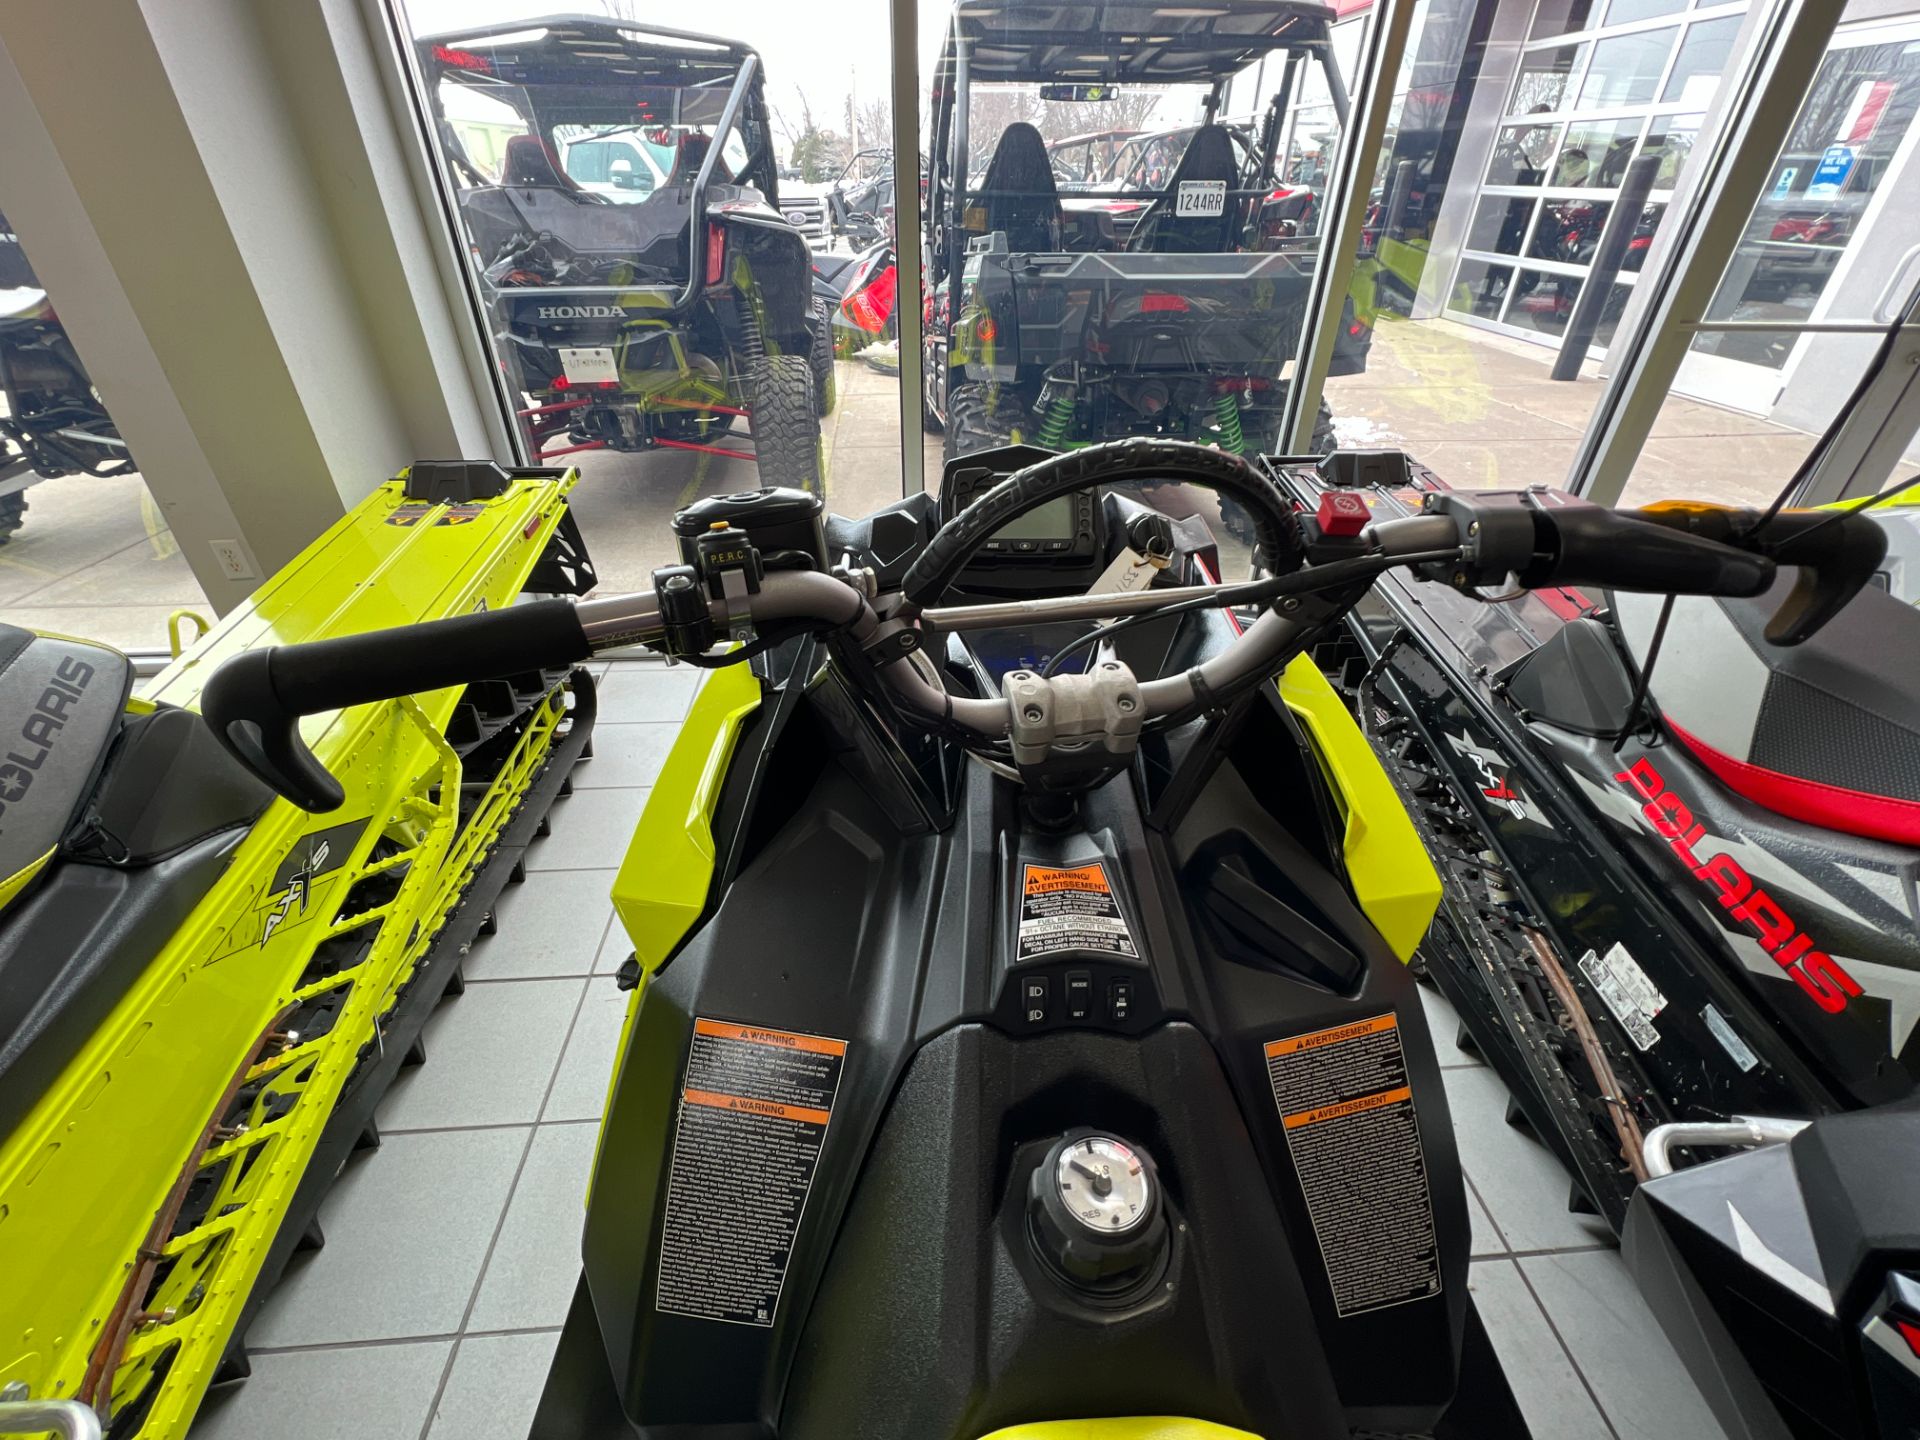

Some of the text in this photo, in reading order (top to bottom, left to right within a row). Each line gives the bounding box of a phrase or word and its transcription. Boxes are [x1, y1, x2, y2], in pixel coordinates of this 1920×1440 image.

[1180, 194, 1222, 211] 1244RR
[538, 306, 628, 318] HONDA
[0, 655, 95, 835] OLARIS
[1029, 881, 1106, 892] AVERTISSEMENT
[1613, 756, 1866, 1014] POLARIS
[1058, 916, 1112, 924] RECOMMENDED
[1035, 932, 1063, 941] MAXIMUM
[1065, 930, 1106, 938] PERFORMANCE
[1096, 925, 1125, 933] ETHANOL
[1024, 940, 1044, 948] DECAL
[750, 1031, 796, 1046] WARNING
[1305, 1024, 1373, 1048] AVERTISSEMENT
[739, 1100, 785, 1115] WARNING
[1318, 1095, 1388, 1119] AVERTISSEMENT
[1082, 1209, 1101, 1219] RES
